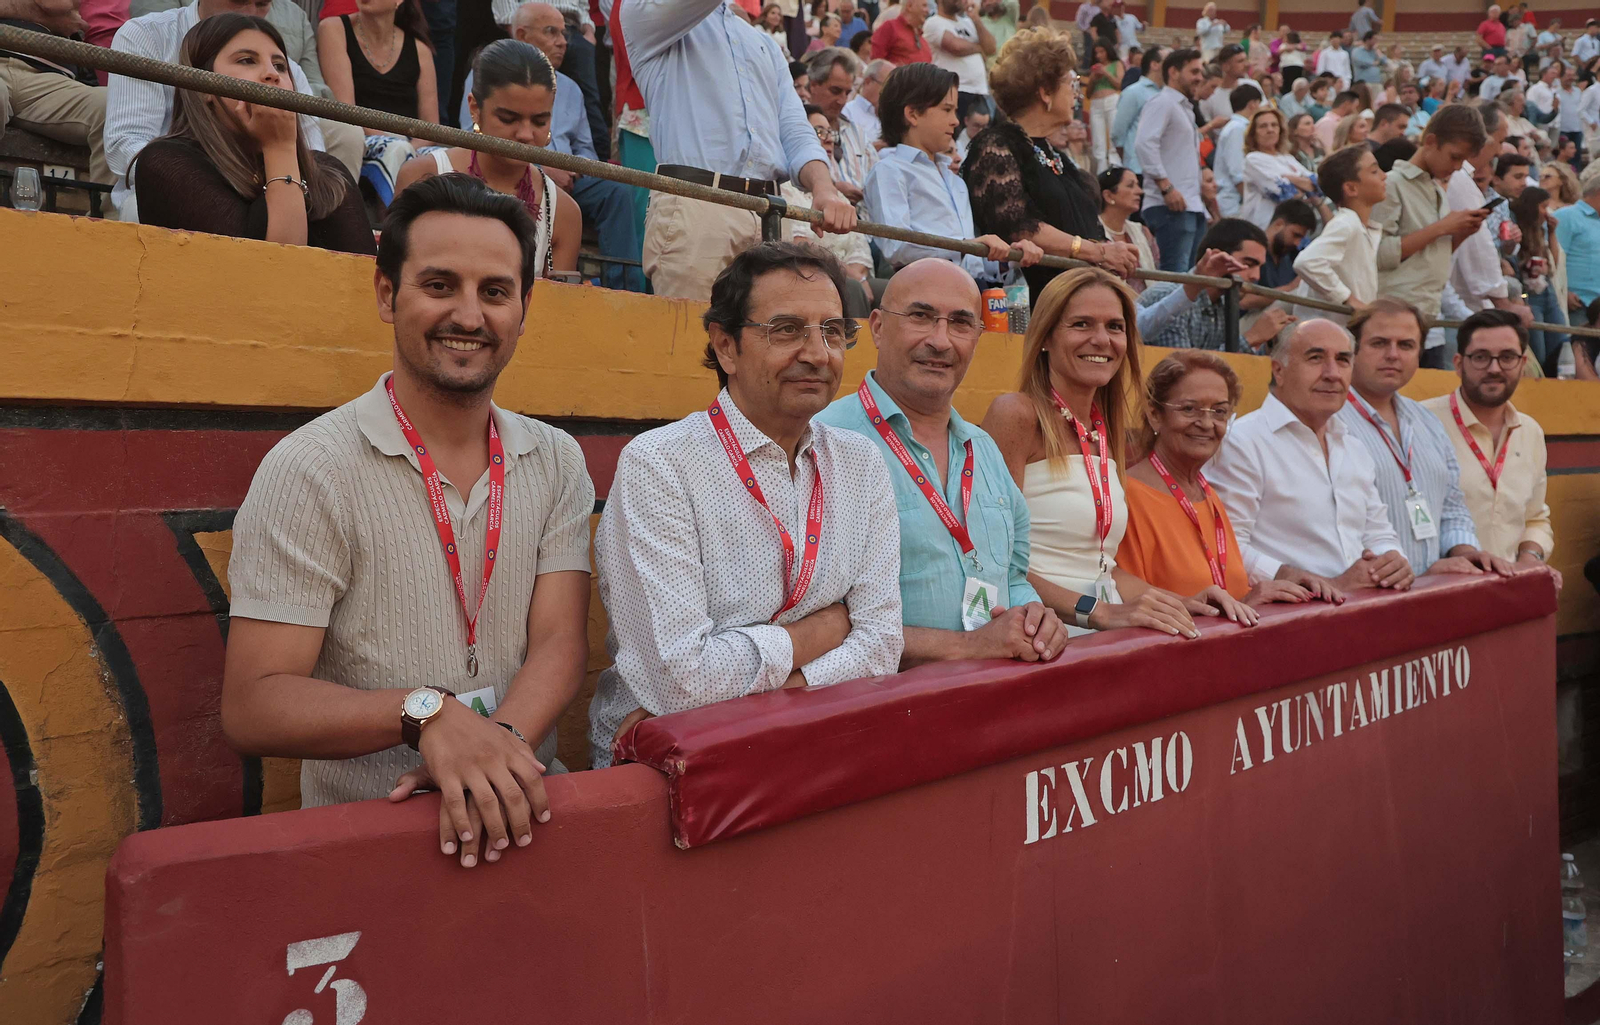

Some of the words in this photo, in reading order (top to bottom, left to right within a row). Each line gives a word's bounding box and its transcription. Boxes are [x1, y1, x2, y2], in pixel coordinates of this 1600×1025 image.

[427, 476, 443, 522] ESPECTÁCULOS
[438, 496, 450, 524] CARMELO
[1024, 731, 1194, 845] EXCMO
[1230, 645, 1471, 775] AYUNTAMIENTO
